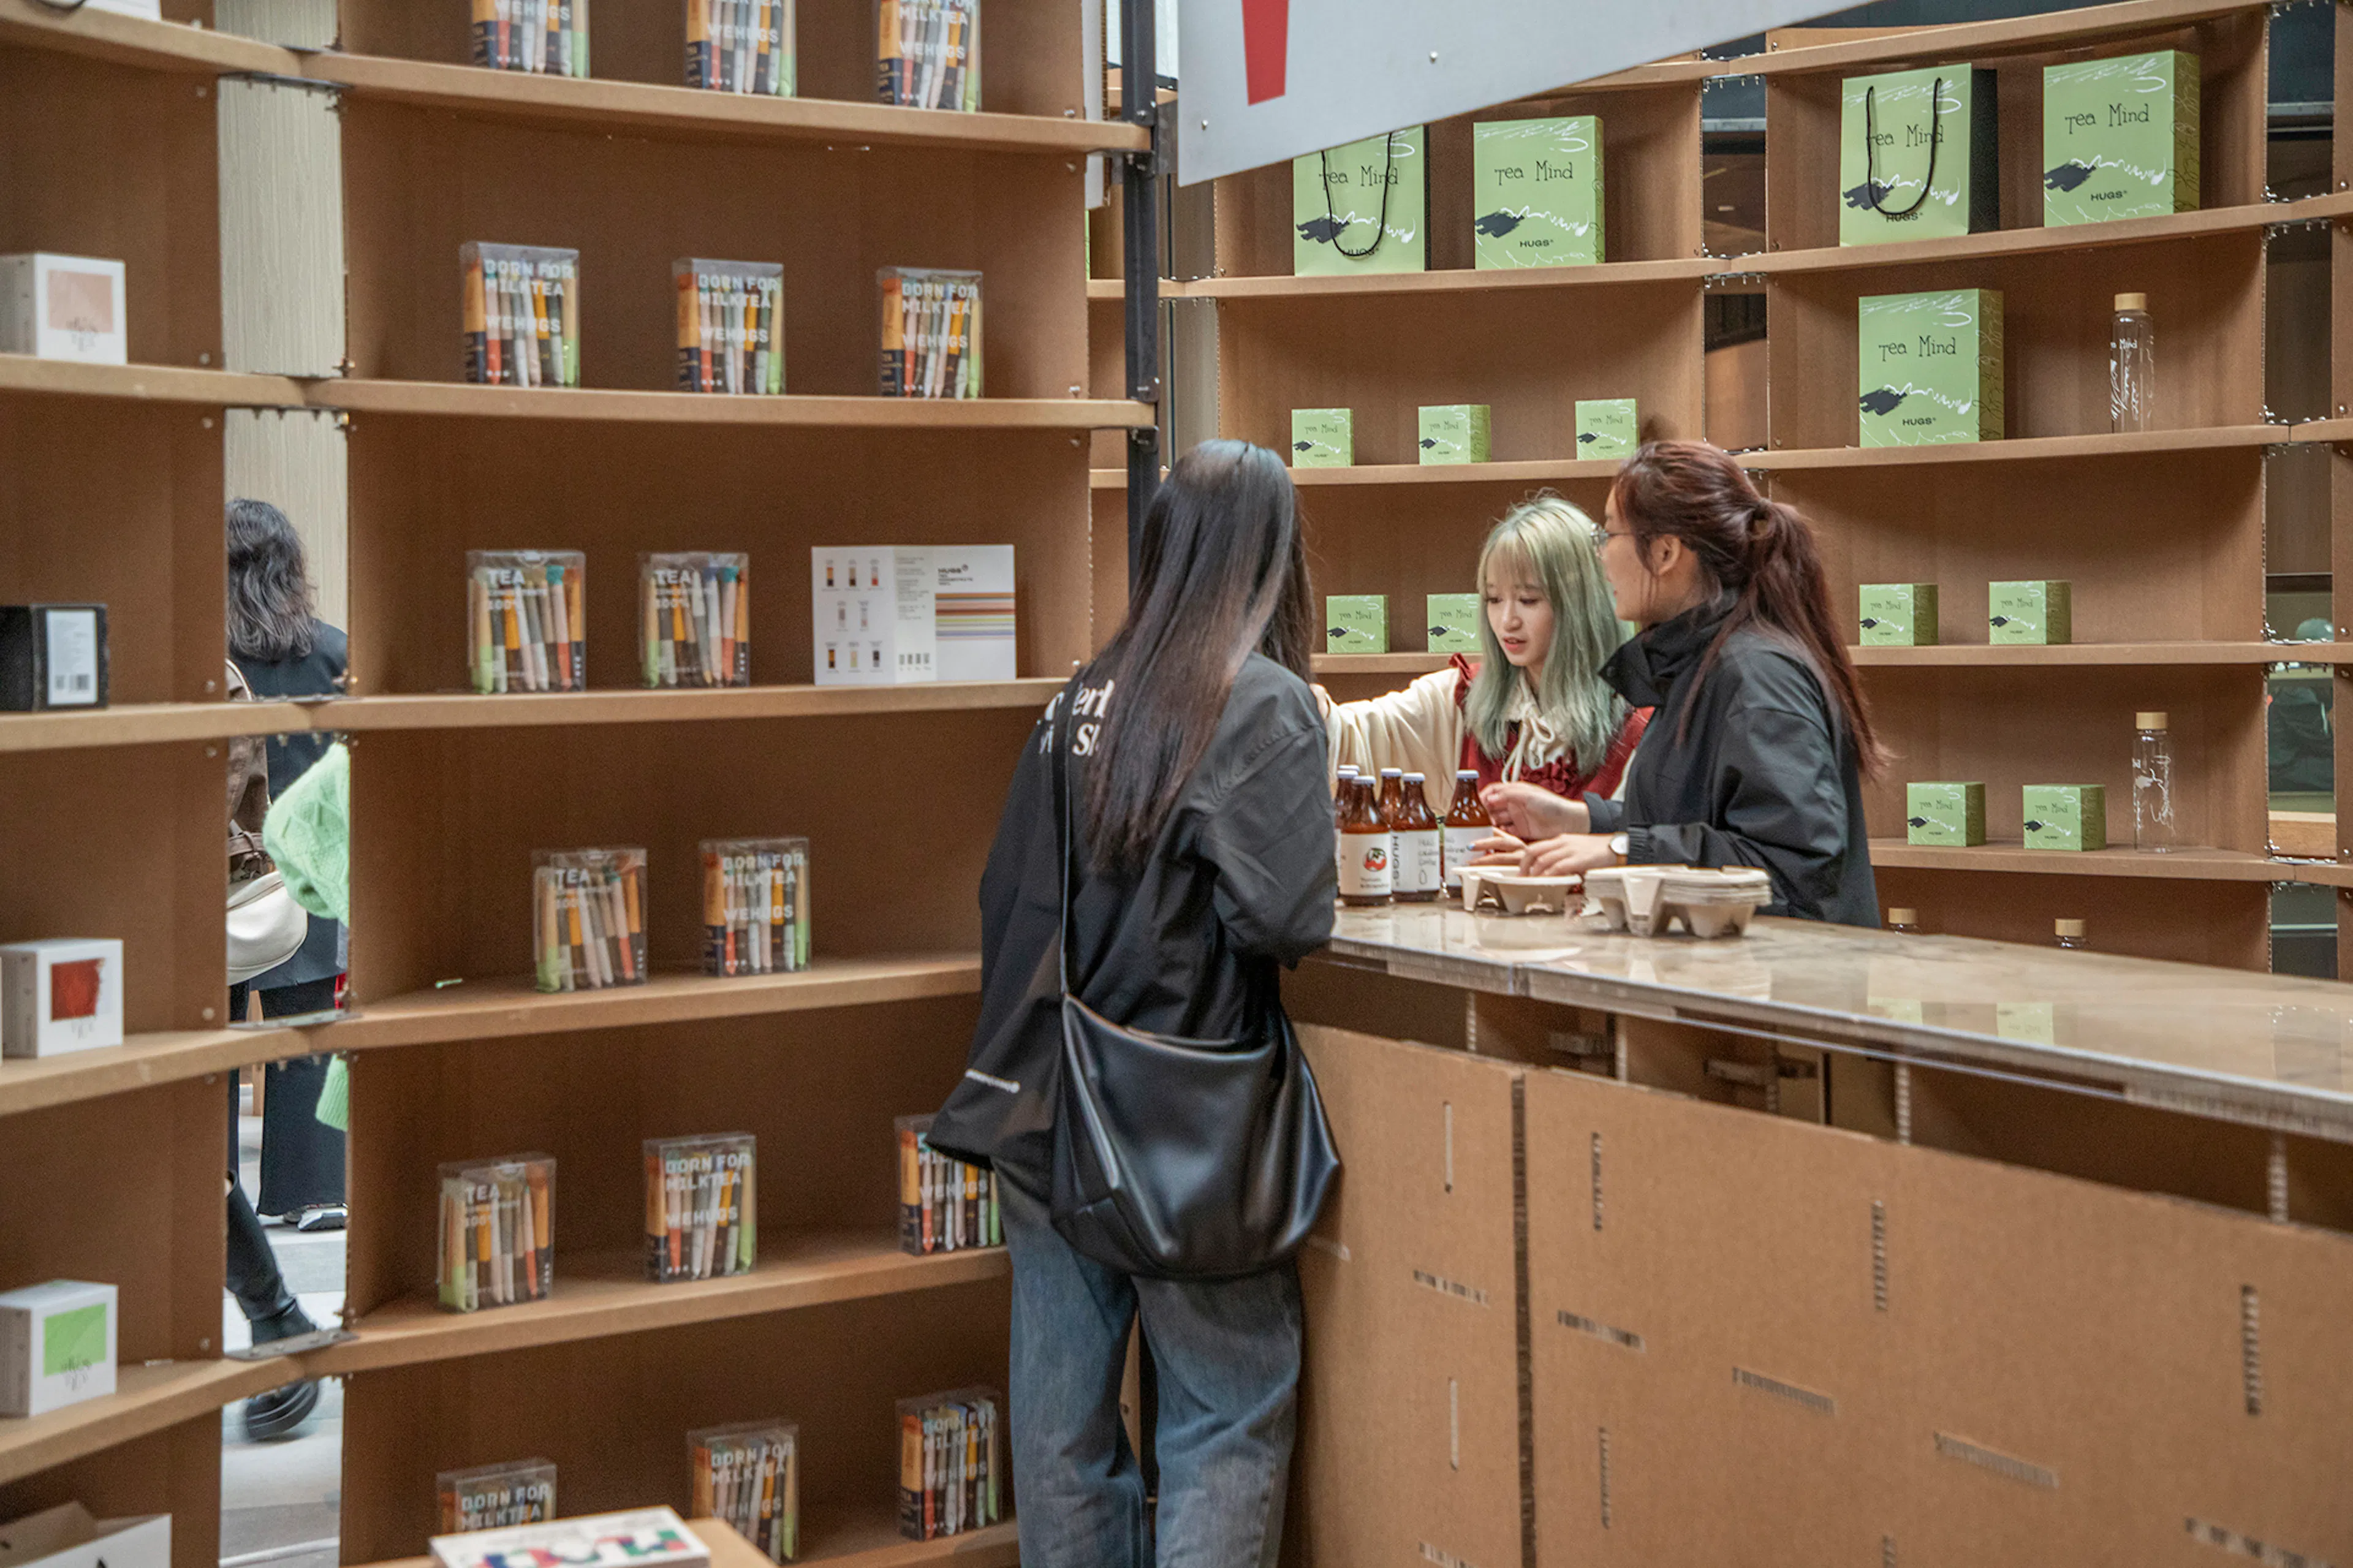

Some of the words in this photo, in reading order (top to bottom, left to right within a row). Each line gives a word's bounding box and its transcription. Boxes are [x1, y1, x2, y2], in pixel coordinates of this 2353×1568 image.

[2065, 113, 2096, 134] Tea
[2109, 104, 2149, 127] Mind
[1906, 124, 1944, 148] Mind
[1360, 165, 1399, 187] Mind
[1495, 164, 1524, 186] Tea
[1536, 160, 1573, 182] Mind
[2090, 191, 2121, 201] HUGS
[1520, 239, 1550, 248] HUGS
[1879, 342, 1907, 362] Tea
[1919, 335, 1957, 357] Mind
[654, 569, 691, 585] TEA
